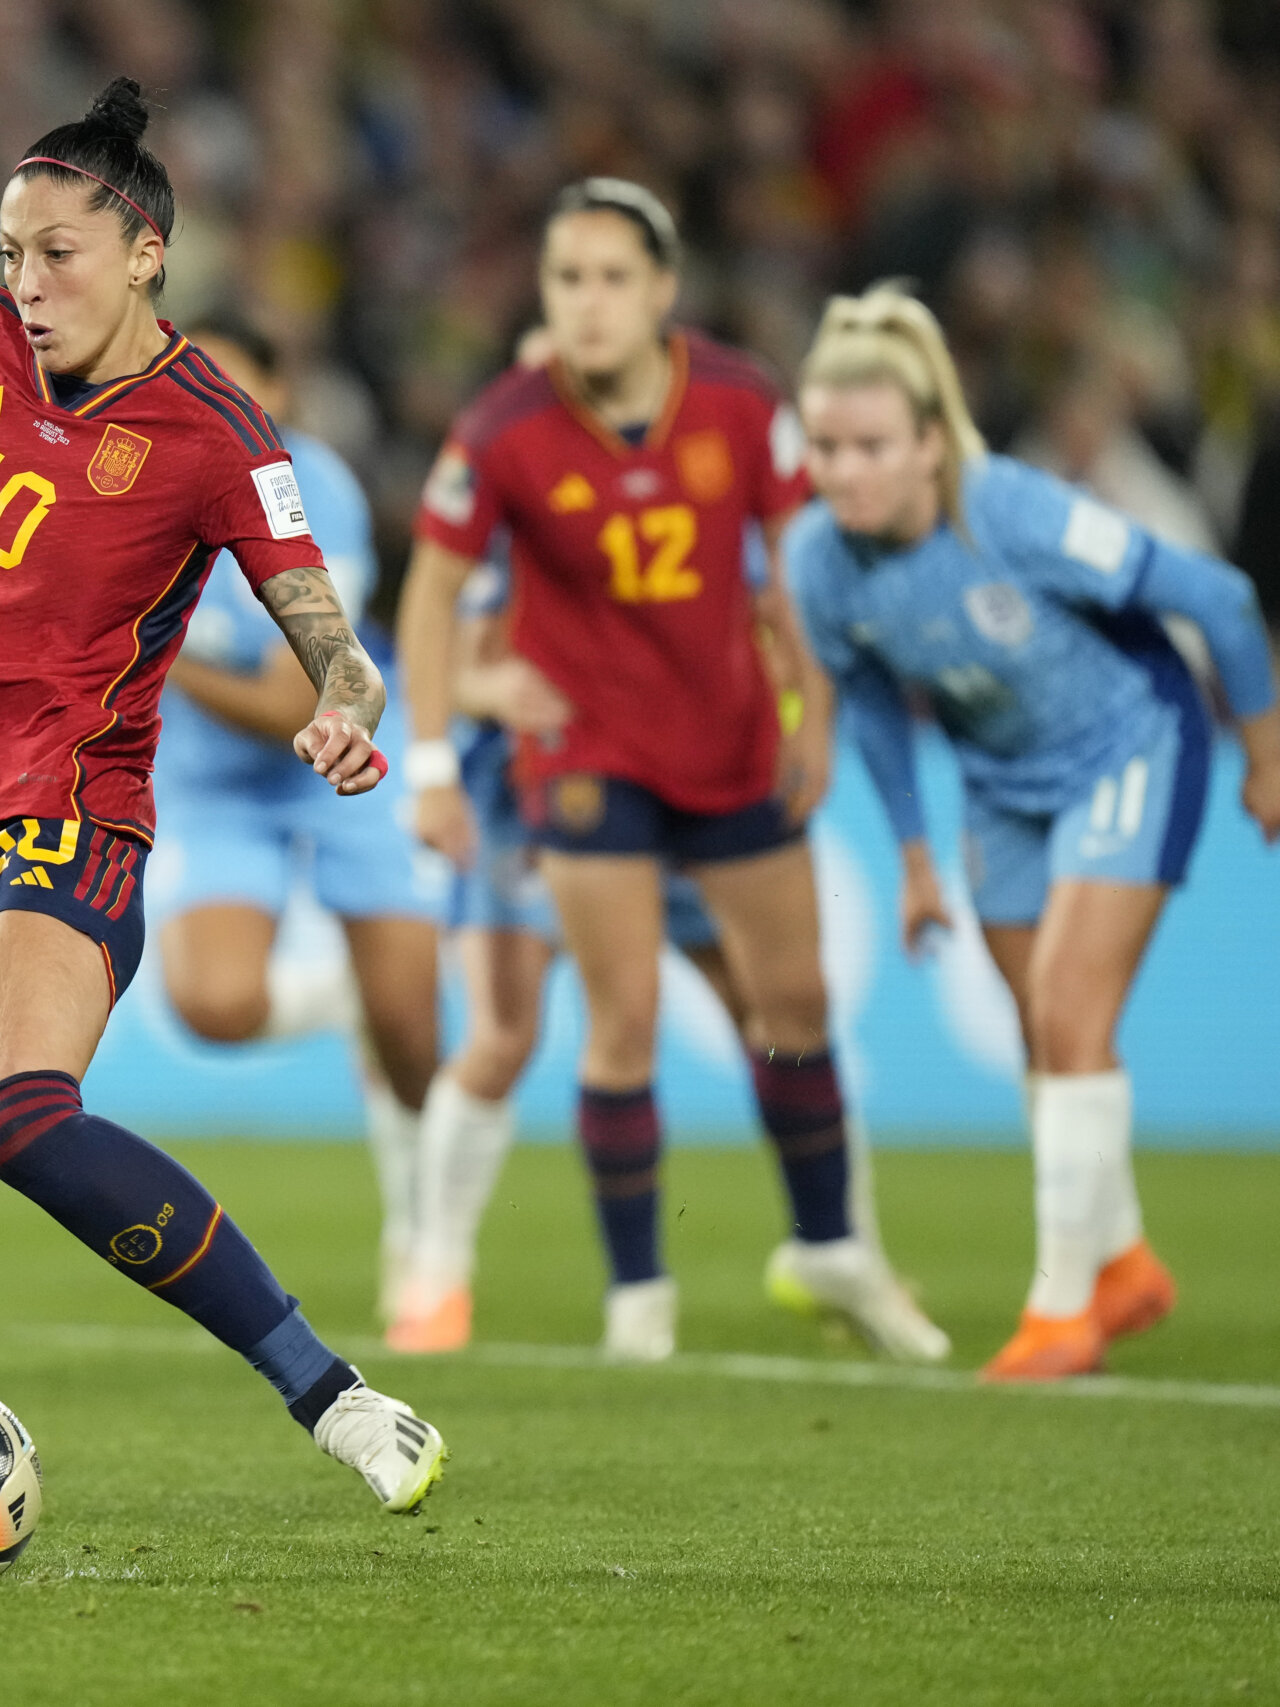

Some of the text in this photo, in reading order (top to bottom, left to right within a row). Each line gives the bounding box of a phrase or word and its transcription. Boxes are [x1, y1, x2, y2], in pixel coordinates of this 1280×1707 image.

[33, 420, 70, 445] 20 AUGUST 2023
[39, 431, 58, 445] SYDNEY
[43, 419, 64, 435] ENGLAND
[598, 507, 701, 602] 12
[1090, 756, 1148, 838] 11
[157, 1202, 175, 1227] 09
